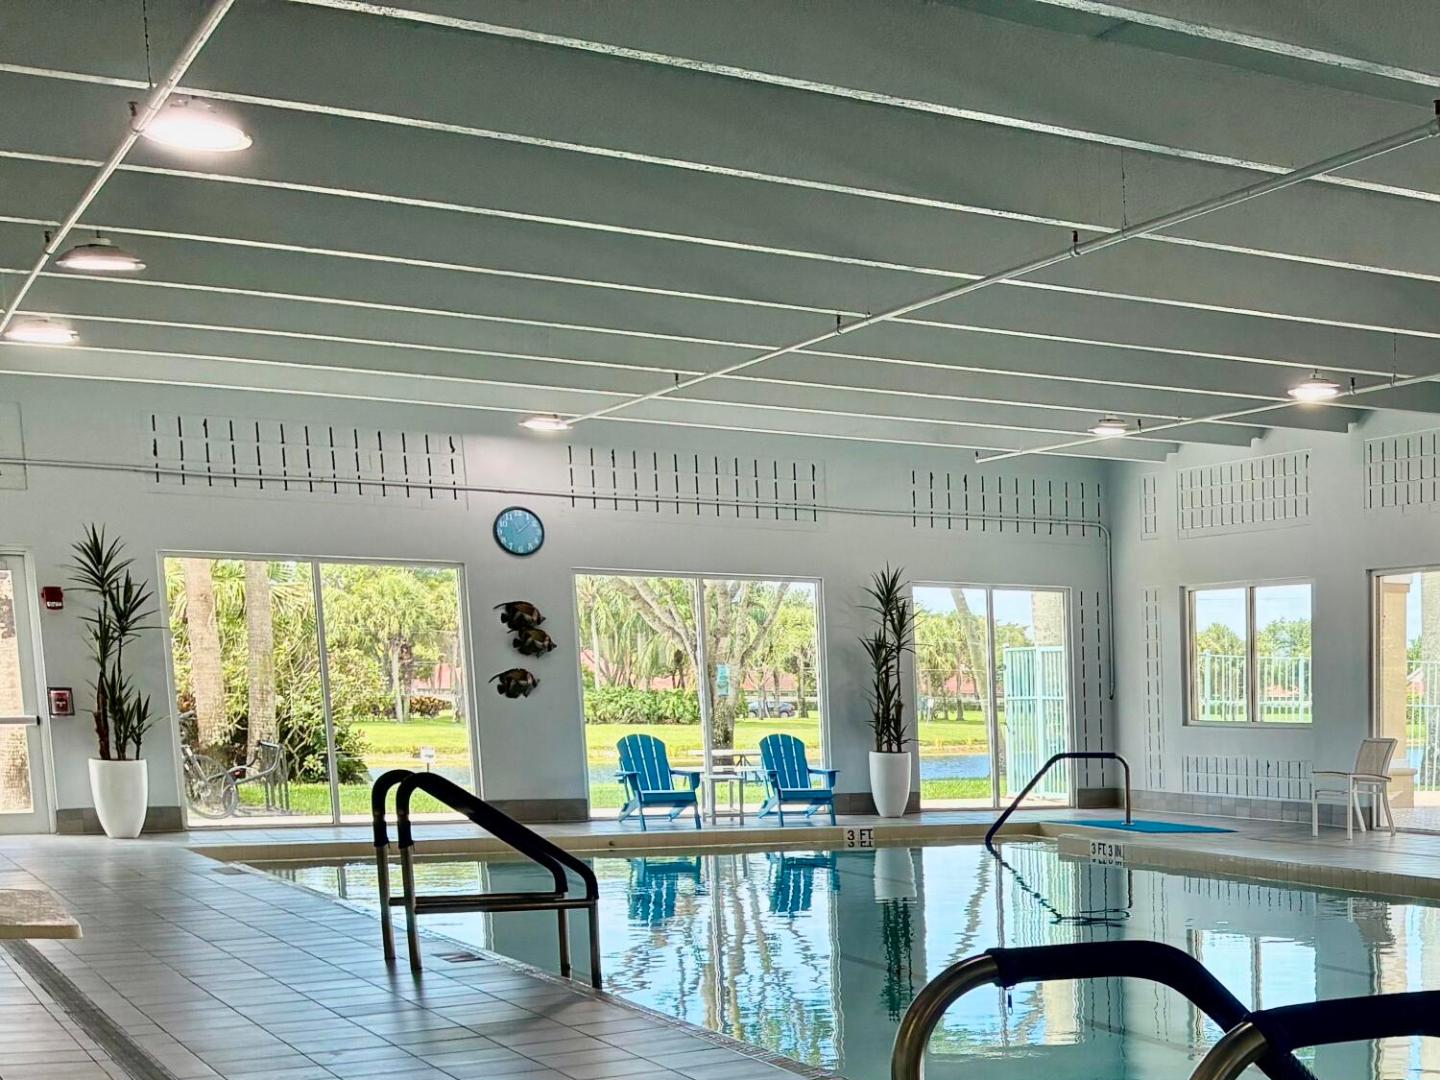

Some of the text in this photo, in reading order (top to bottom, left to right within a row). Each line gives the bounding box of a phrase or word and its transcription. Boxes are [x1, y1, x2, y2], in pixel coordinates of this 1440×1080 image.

[847, 829, 855, 840] 3
[1091, 843, 1096, 855] 3
[1108, 844, 1113, 857] 3
